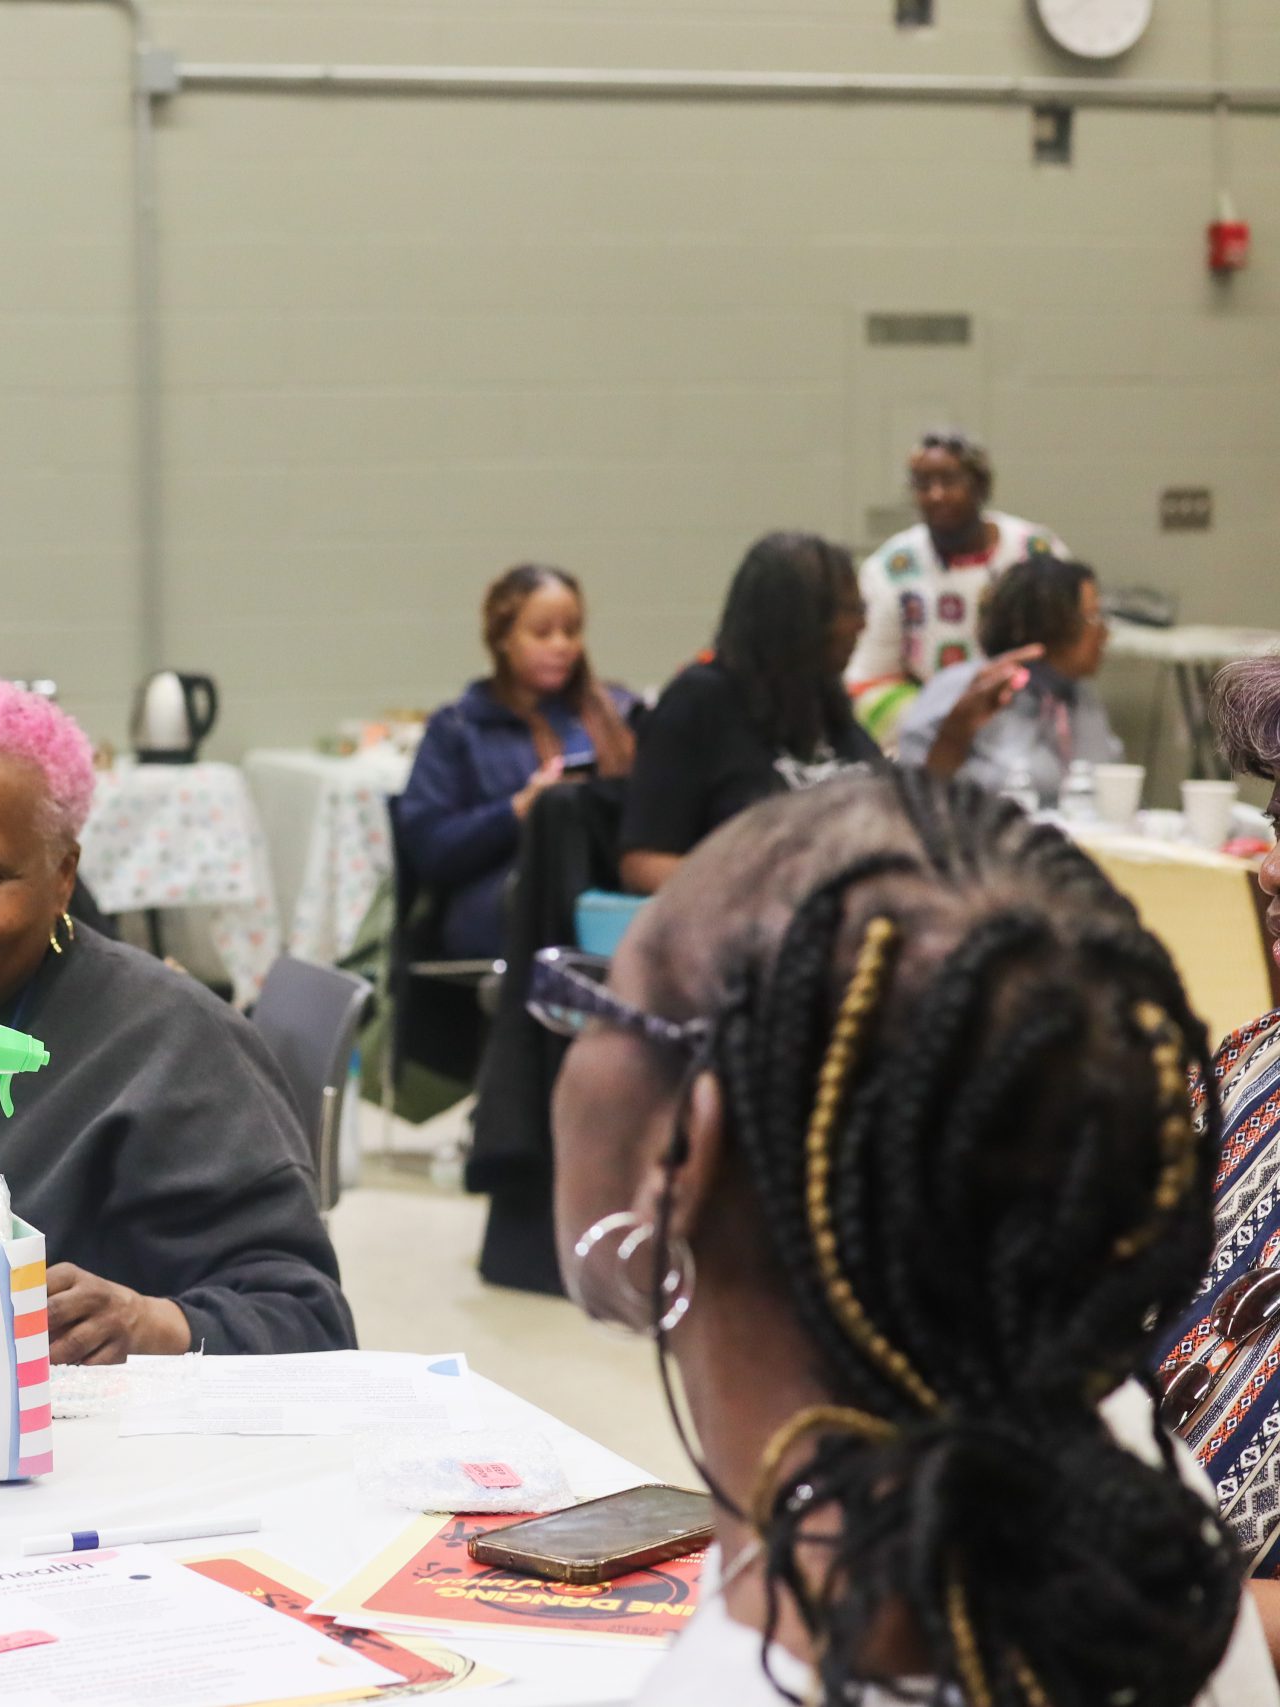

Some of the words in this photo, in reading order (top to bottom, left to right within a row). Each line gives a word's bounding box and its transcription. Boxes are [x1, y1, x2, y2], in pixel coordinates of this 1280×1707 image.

[413, 1577, 544, 1591] Seniors
[434, 1586, 622, 1611] DANCING
[626, 1598, 696, 1616] INE
